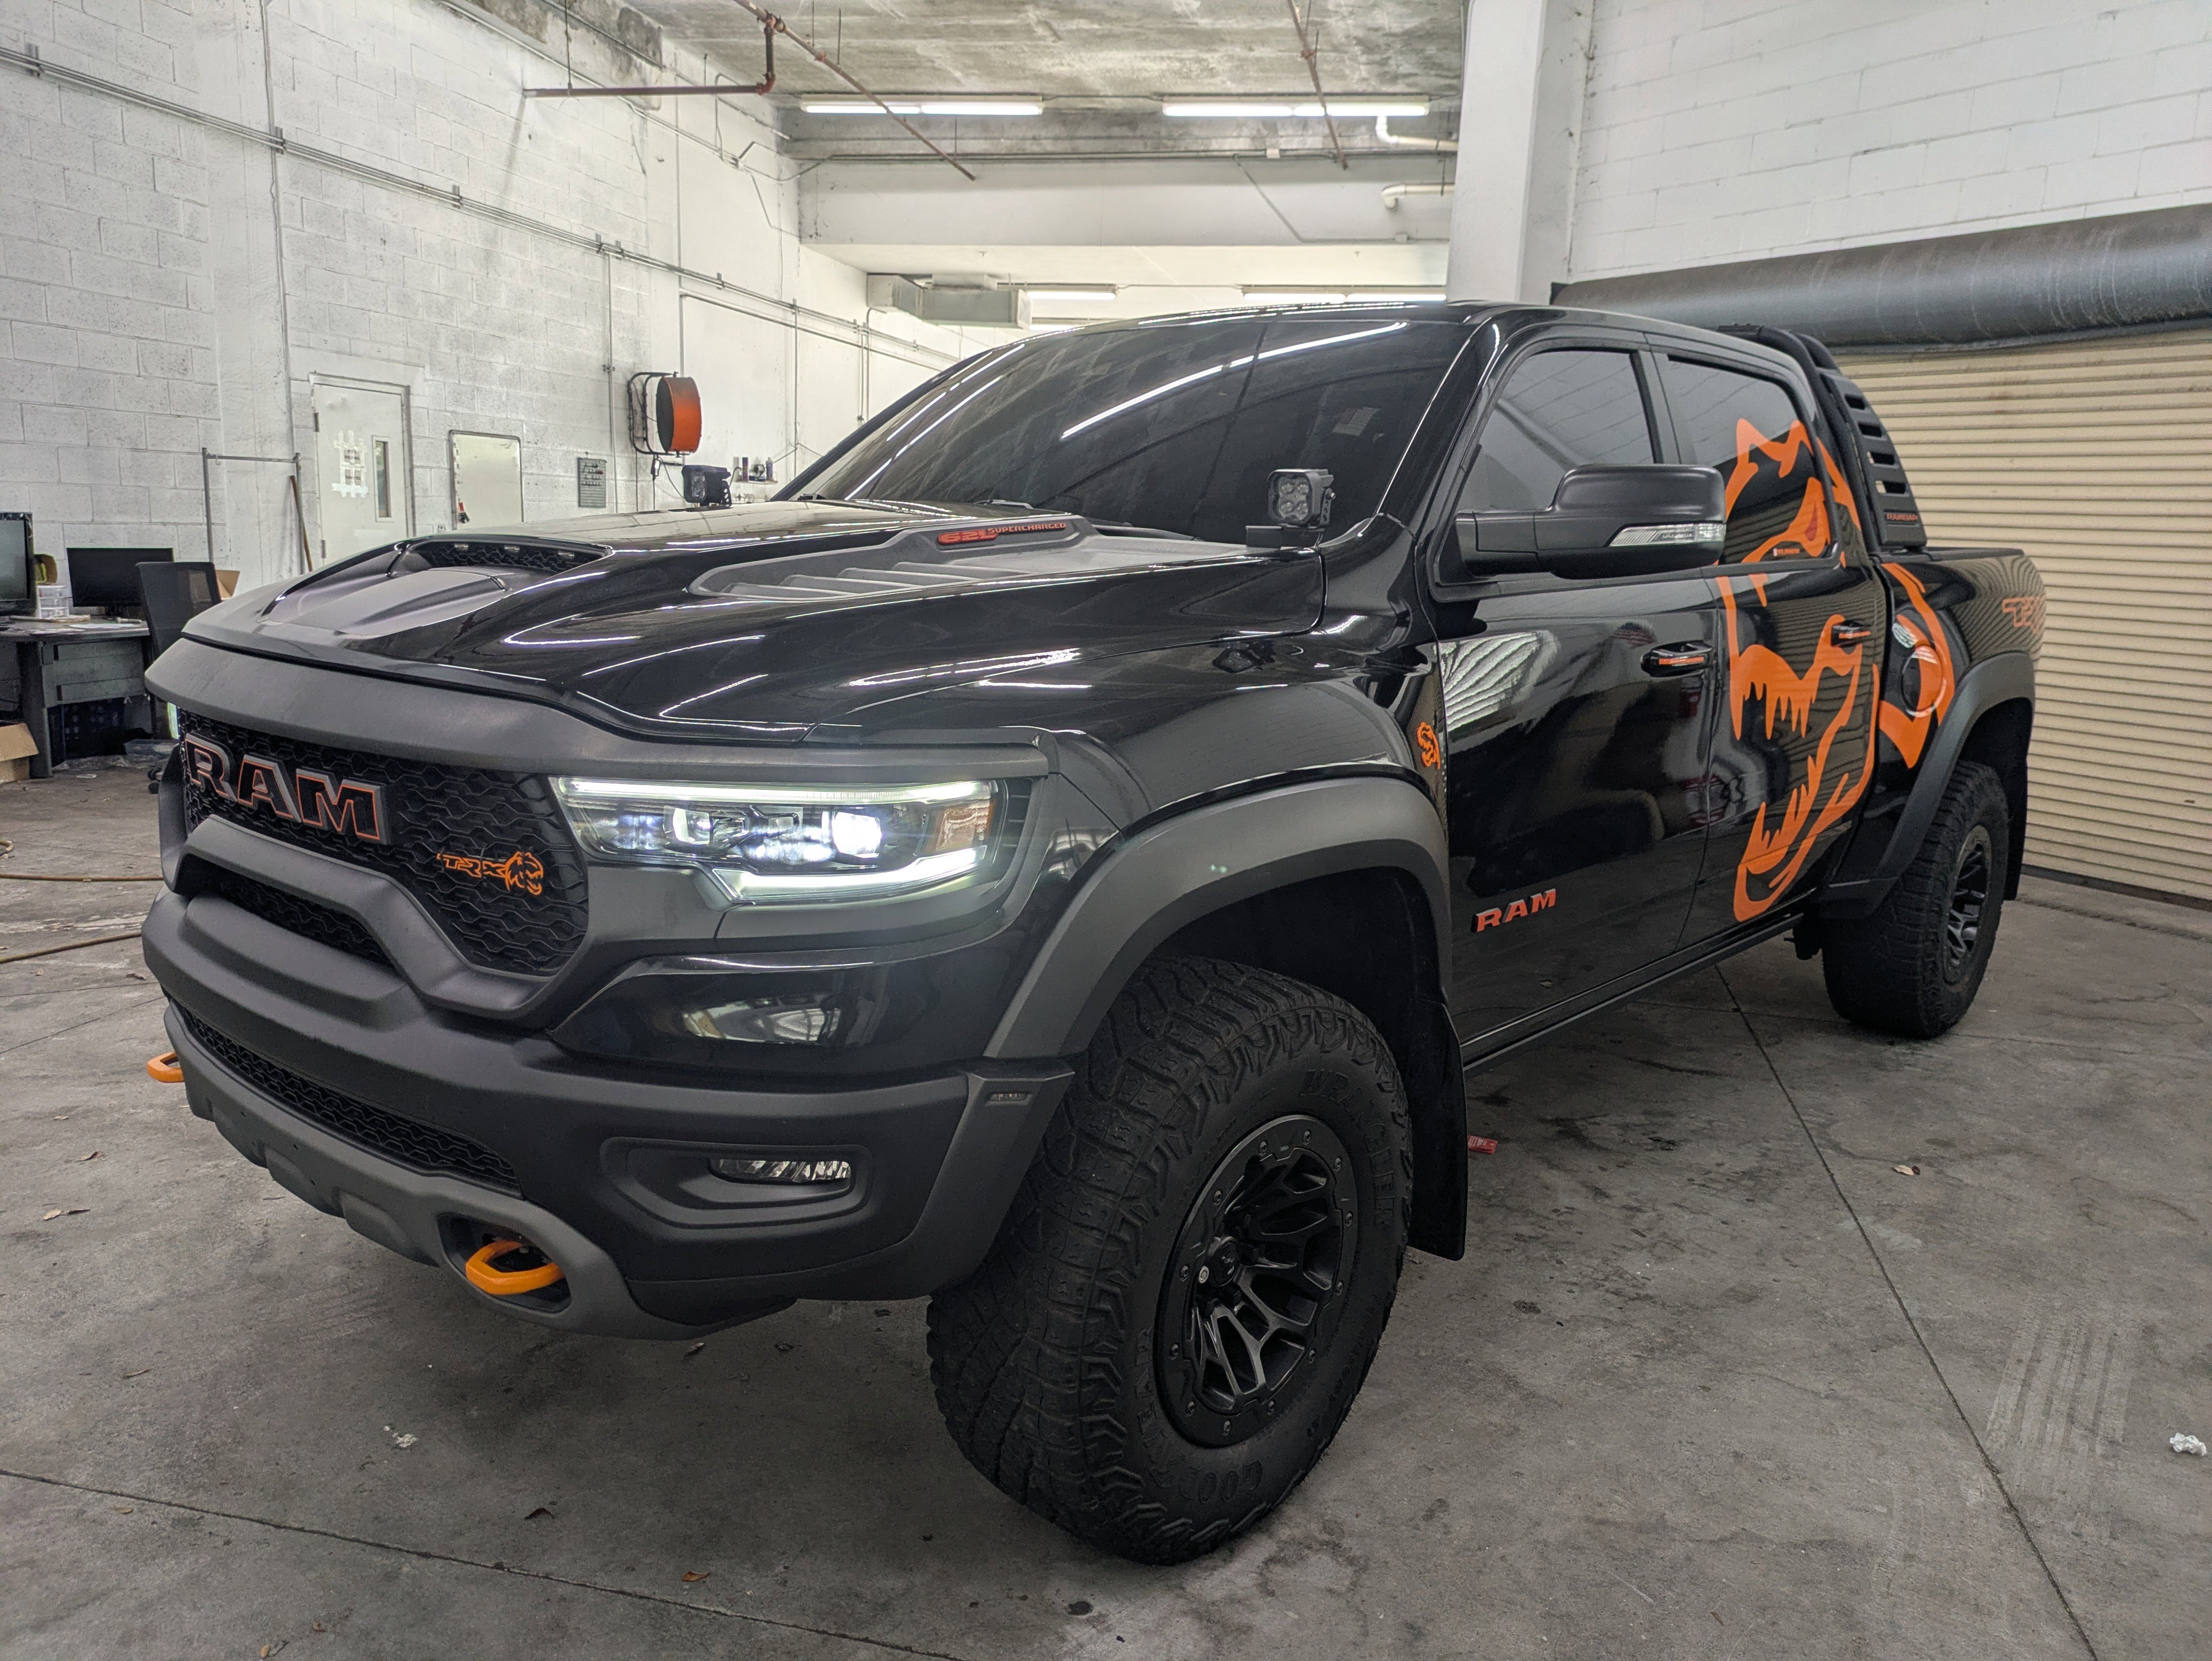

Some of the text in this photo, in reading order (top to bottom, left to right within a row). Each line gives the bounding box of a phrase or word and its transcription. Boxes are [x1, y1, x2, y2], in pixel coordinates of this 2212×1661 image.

[939, 522, 1066, 544] 6.2L SUPERCHARGED
[185, 732, 387, 844] RAM
[436, 853, 507, 878] TRX
[1475, 888, 1556, 932] RAM
